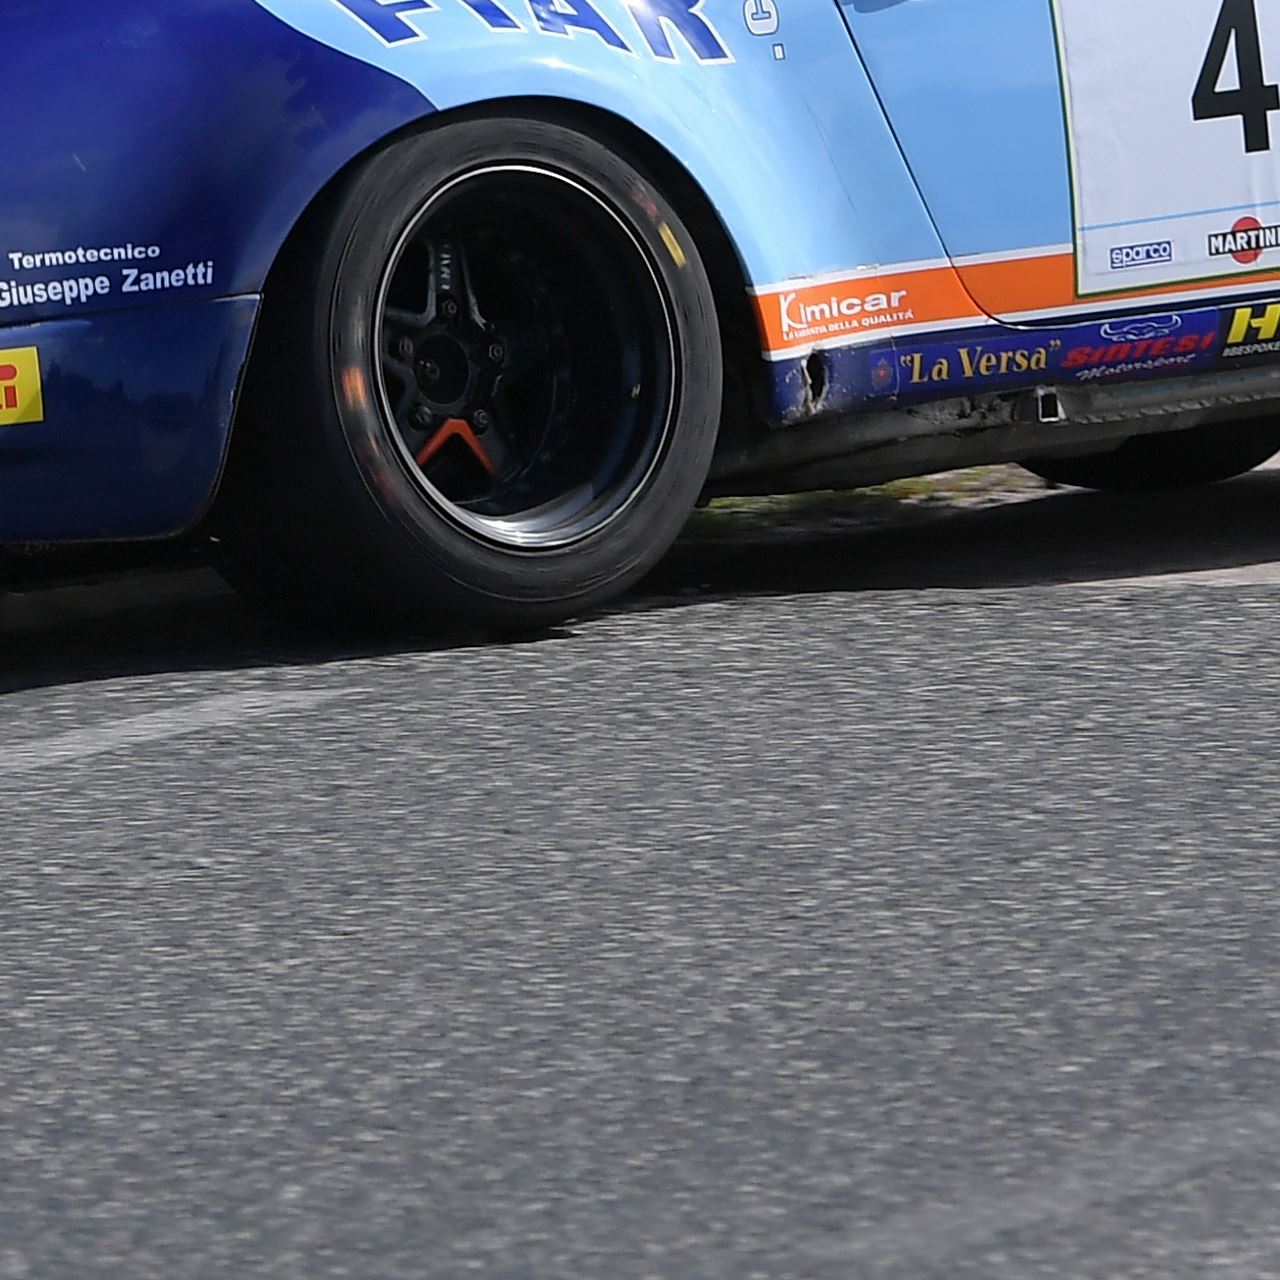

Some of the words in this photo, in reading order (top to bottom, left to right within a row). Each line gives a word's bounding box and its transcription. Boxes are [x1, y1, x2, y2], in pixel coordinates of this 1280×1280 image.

[9, 243, 161, 271] Termotecnico
[1111, 243, 1171, 264] sparco
[121, 261, 214, 292] Zanetti
[779, 290, 907, 332] Kimicar
[1061, 331, 1216, 368] SINTESI
